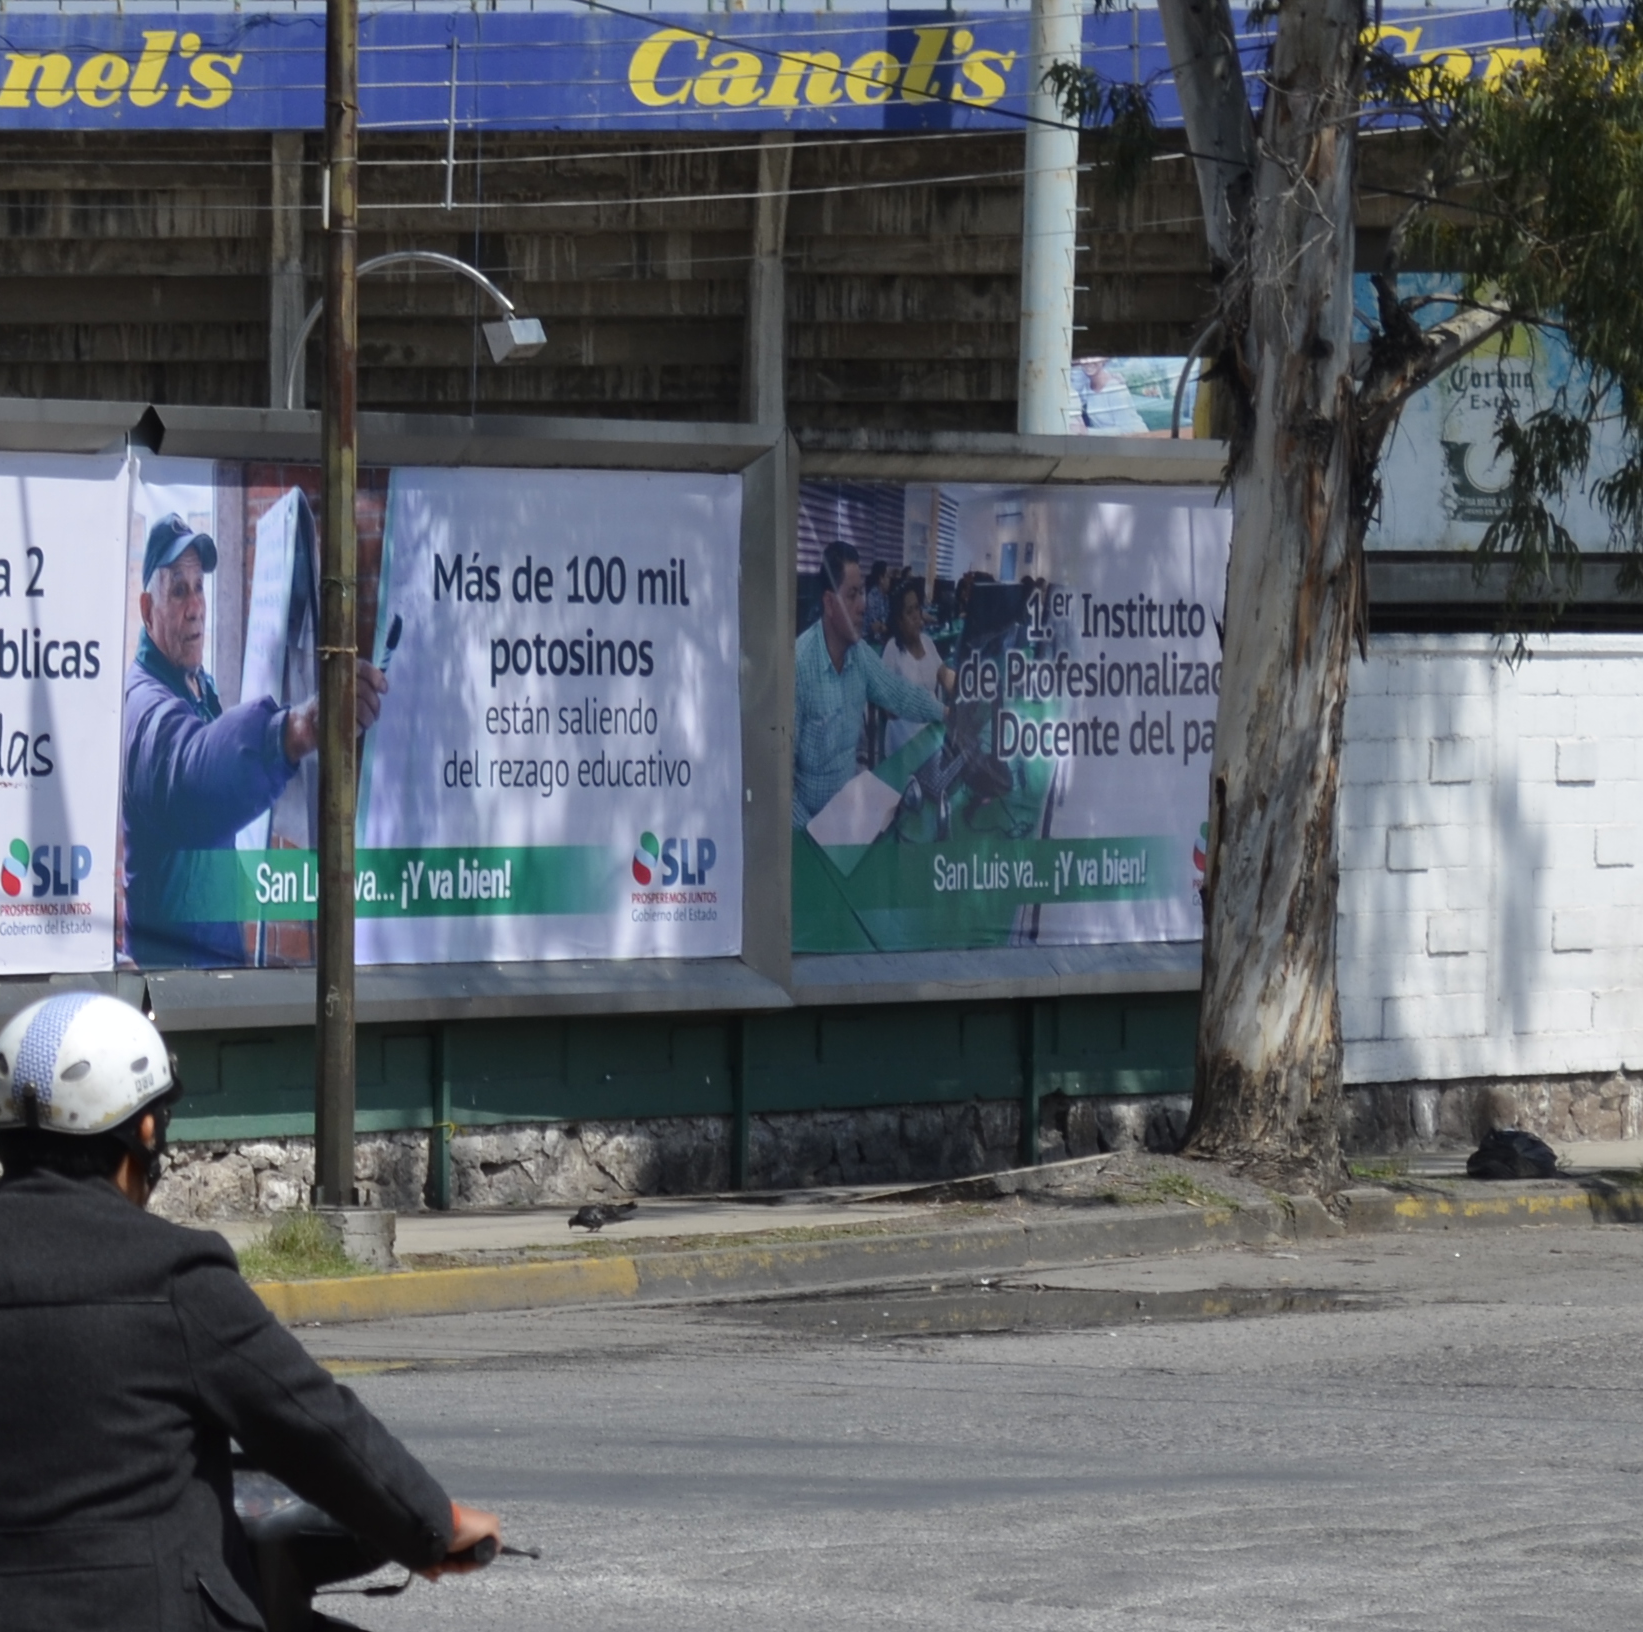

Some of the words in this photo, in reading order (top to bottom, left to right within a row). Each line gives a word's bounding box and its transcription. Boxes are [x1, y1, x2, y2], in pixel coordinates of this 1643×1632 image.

[628, 27, 1016, 108] Canel's
[1450, 365, 1535, 393] Corona
[24, 546, 45, 597] 2
[433, 552, 501, 603] Más
[512, 555, 554, 603] de
[565, 555, 627, 605] 100
[637, 557, 690, 607] mil
[1081, 592, 1206, 639] Instituto
[490, 627, 655, 688] potosinos
[960, 652, 998, 699] de
[1007, 651, 1223, 699] Profesionalizac
[485, 695, 550, 735] están
[558, 697, 658, 735] saliendo
[999, 710, 1120, 758] Docente
[1129, 711, 1175, 756] del
[1183, 719, 1217, 766] pa
[443, 749, 482, 788] del
[489, 757, 570, 797] rezago
[577, 749, 692, 788] educativo
[31, 844, 92, 898] SLP
[255, 862, 298, 904] San
[401, 861, 425, 910] ¡Y
[427, 869, 454, 901] va
[458, 858, 512, 899] bien!
[661, 838, 717, 887] SLP
[933, 854, 968, 892] San
[973, 852, 1009, 890] Luis
[1014, 860, 1049, 889] va...
[1054, 851, 1074, 896] ¡Y
[1077, 857, 1098, 886] va
[1102, 848, 1147, 885] bien!
[0, 903, 59, 917] PROSPEREMOS
[59, 902, 92, 916] JUNTOS
[0, 921, 43, 936] Gobierno
[44, 920, 58, 935] del
[60, 919, 92, 935] Estado
[672, 907, 688, 921] del
[688, 907, 718, 922] Estado
